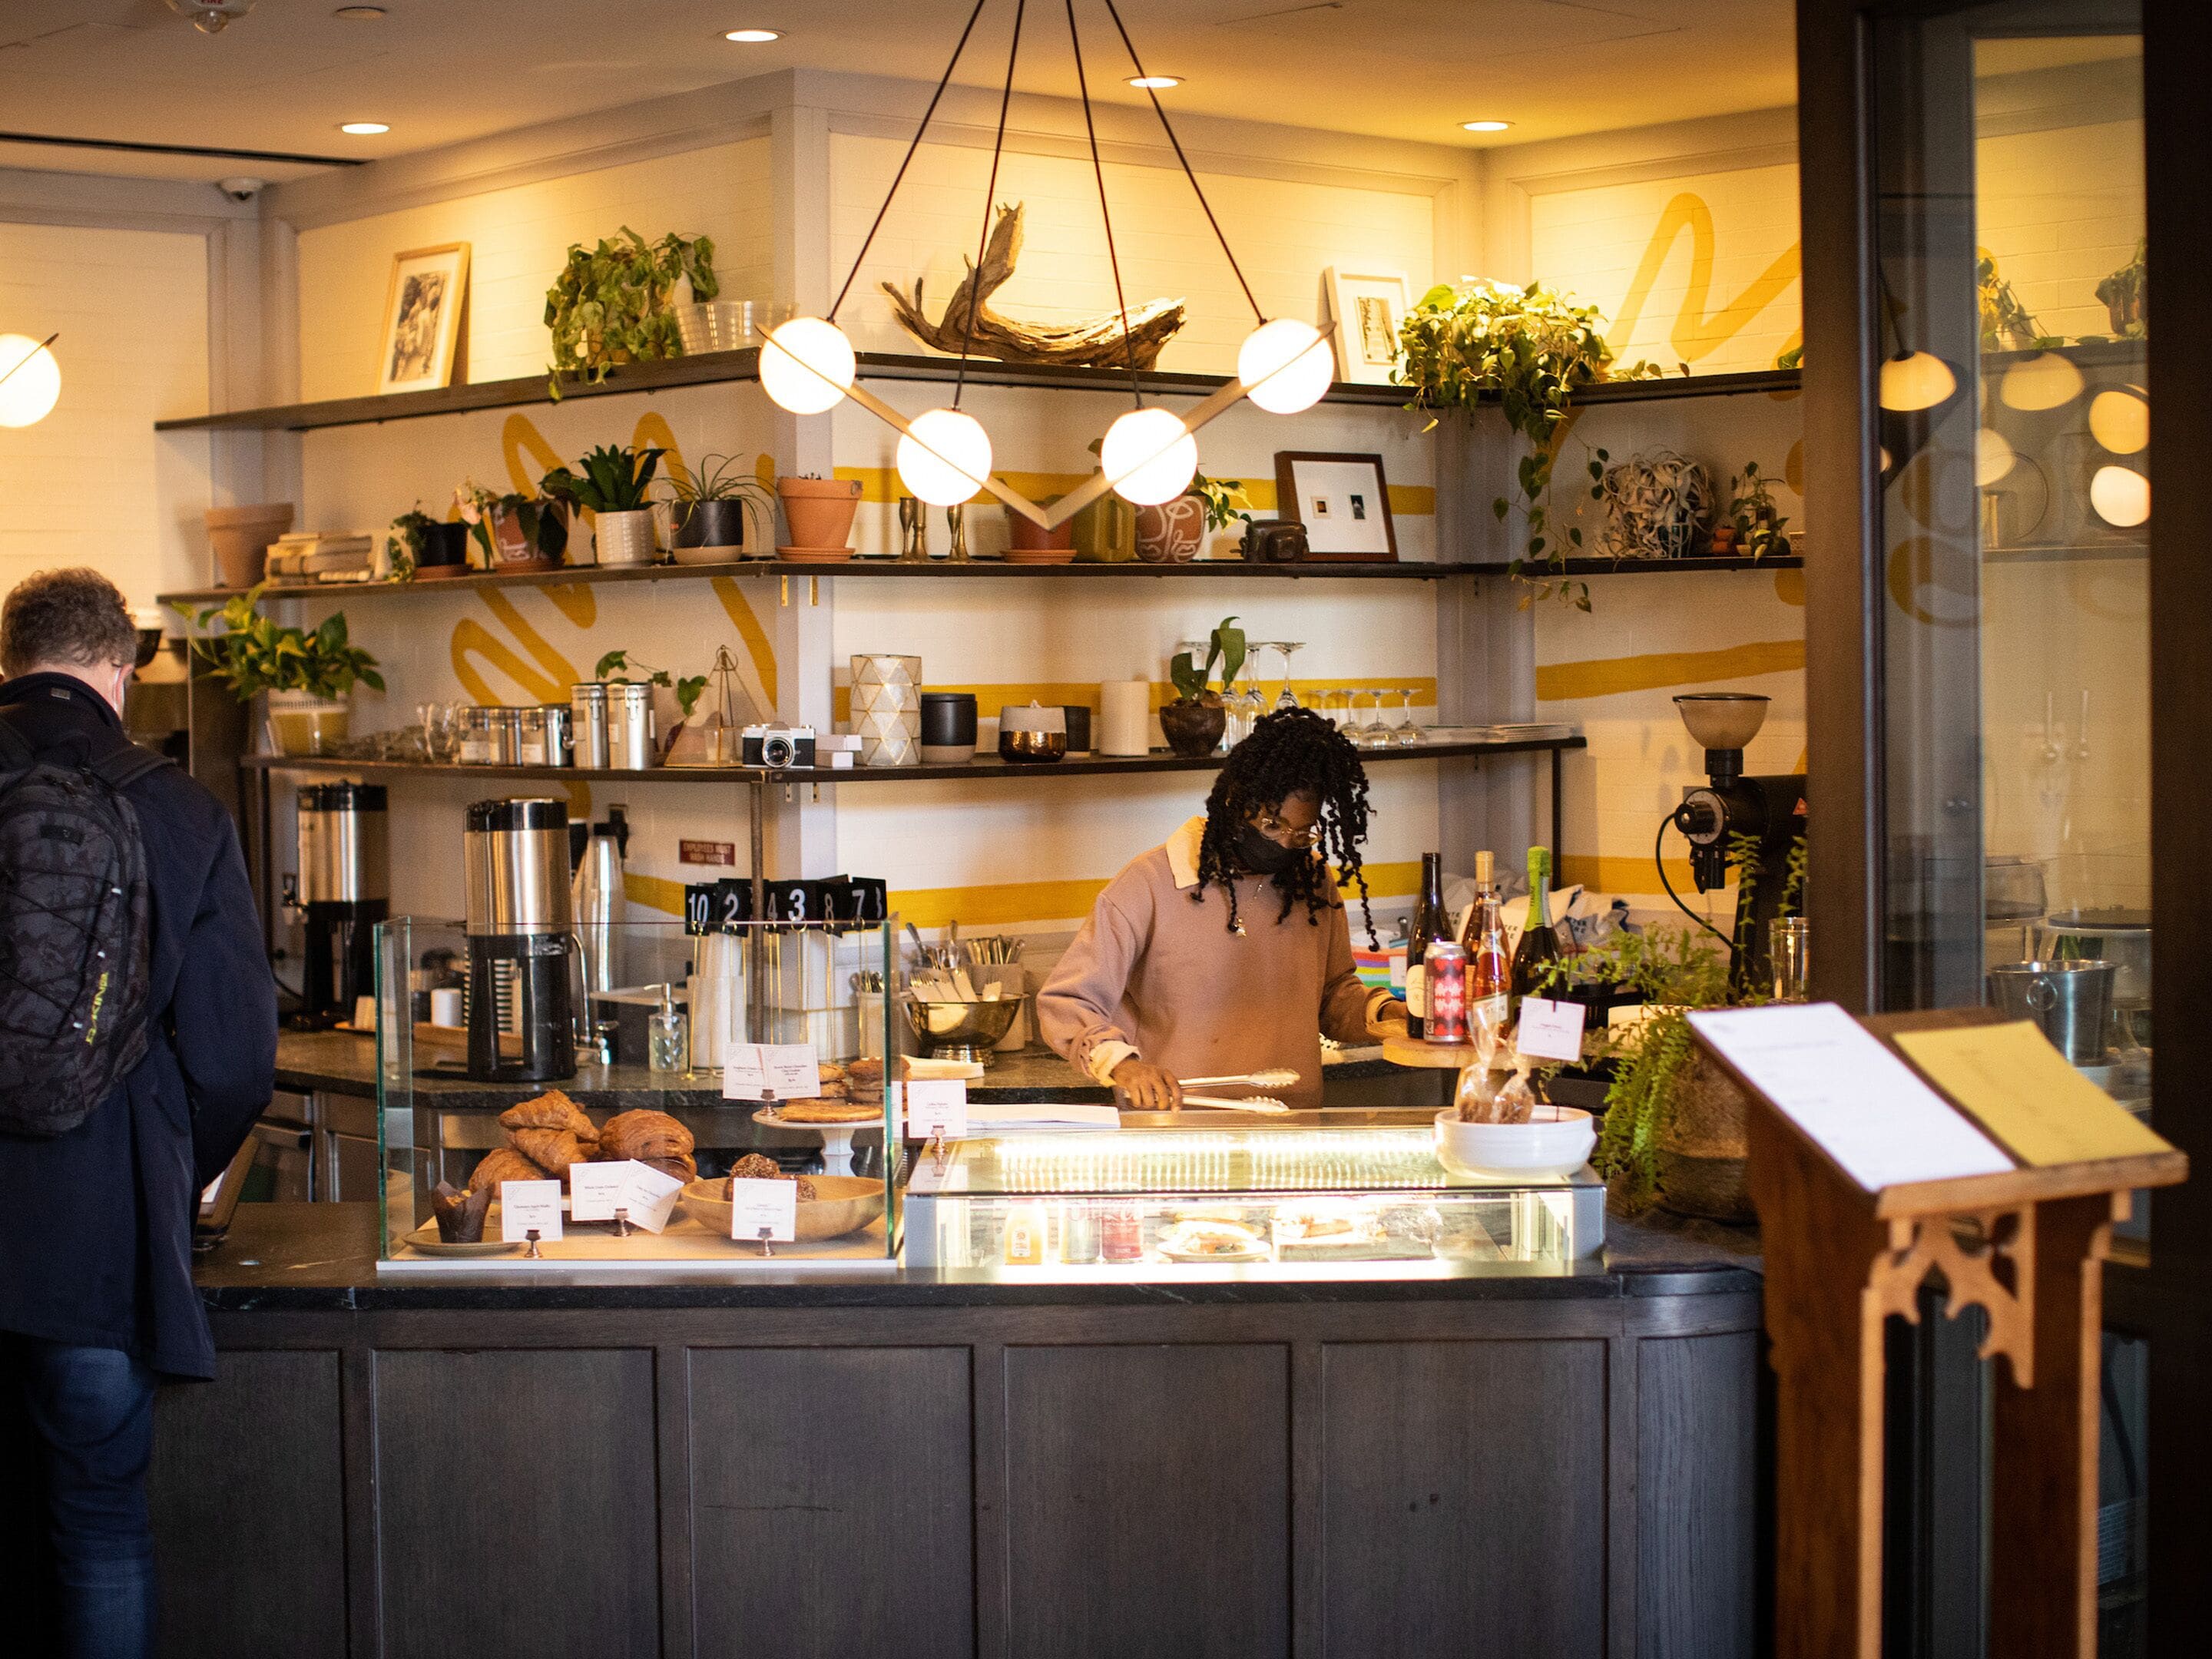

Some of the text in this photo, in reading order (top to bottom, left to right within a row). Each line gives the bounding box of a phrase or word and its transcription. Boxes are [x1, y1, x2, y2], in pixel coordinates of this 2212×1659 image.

[688, 892, 709, 927] 10
[724, 892, 740, 922] 2
[767, 892, 778, 922] 4
[788, 888, 806, 922] 3
[824, 892, 835, 923] 8
[852, 889, 865, 922] 7
